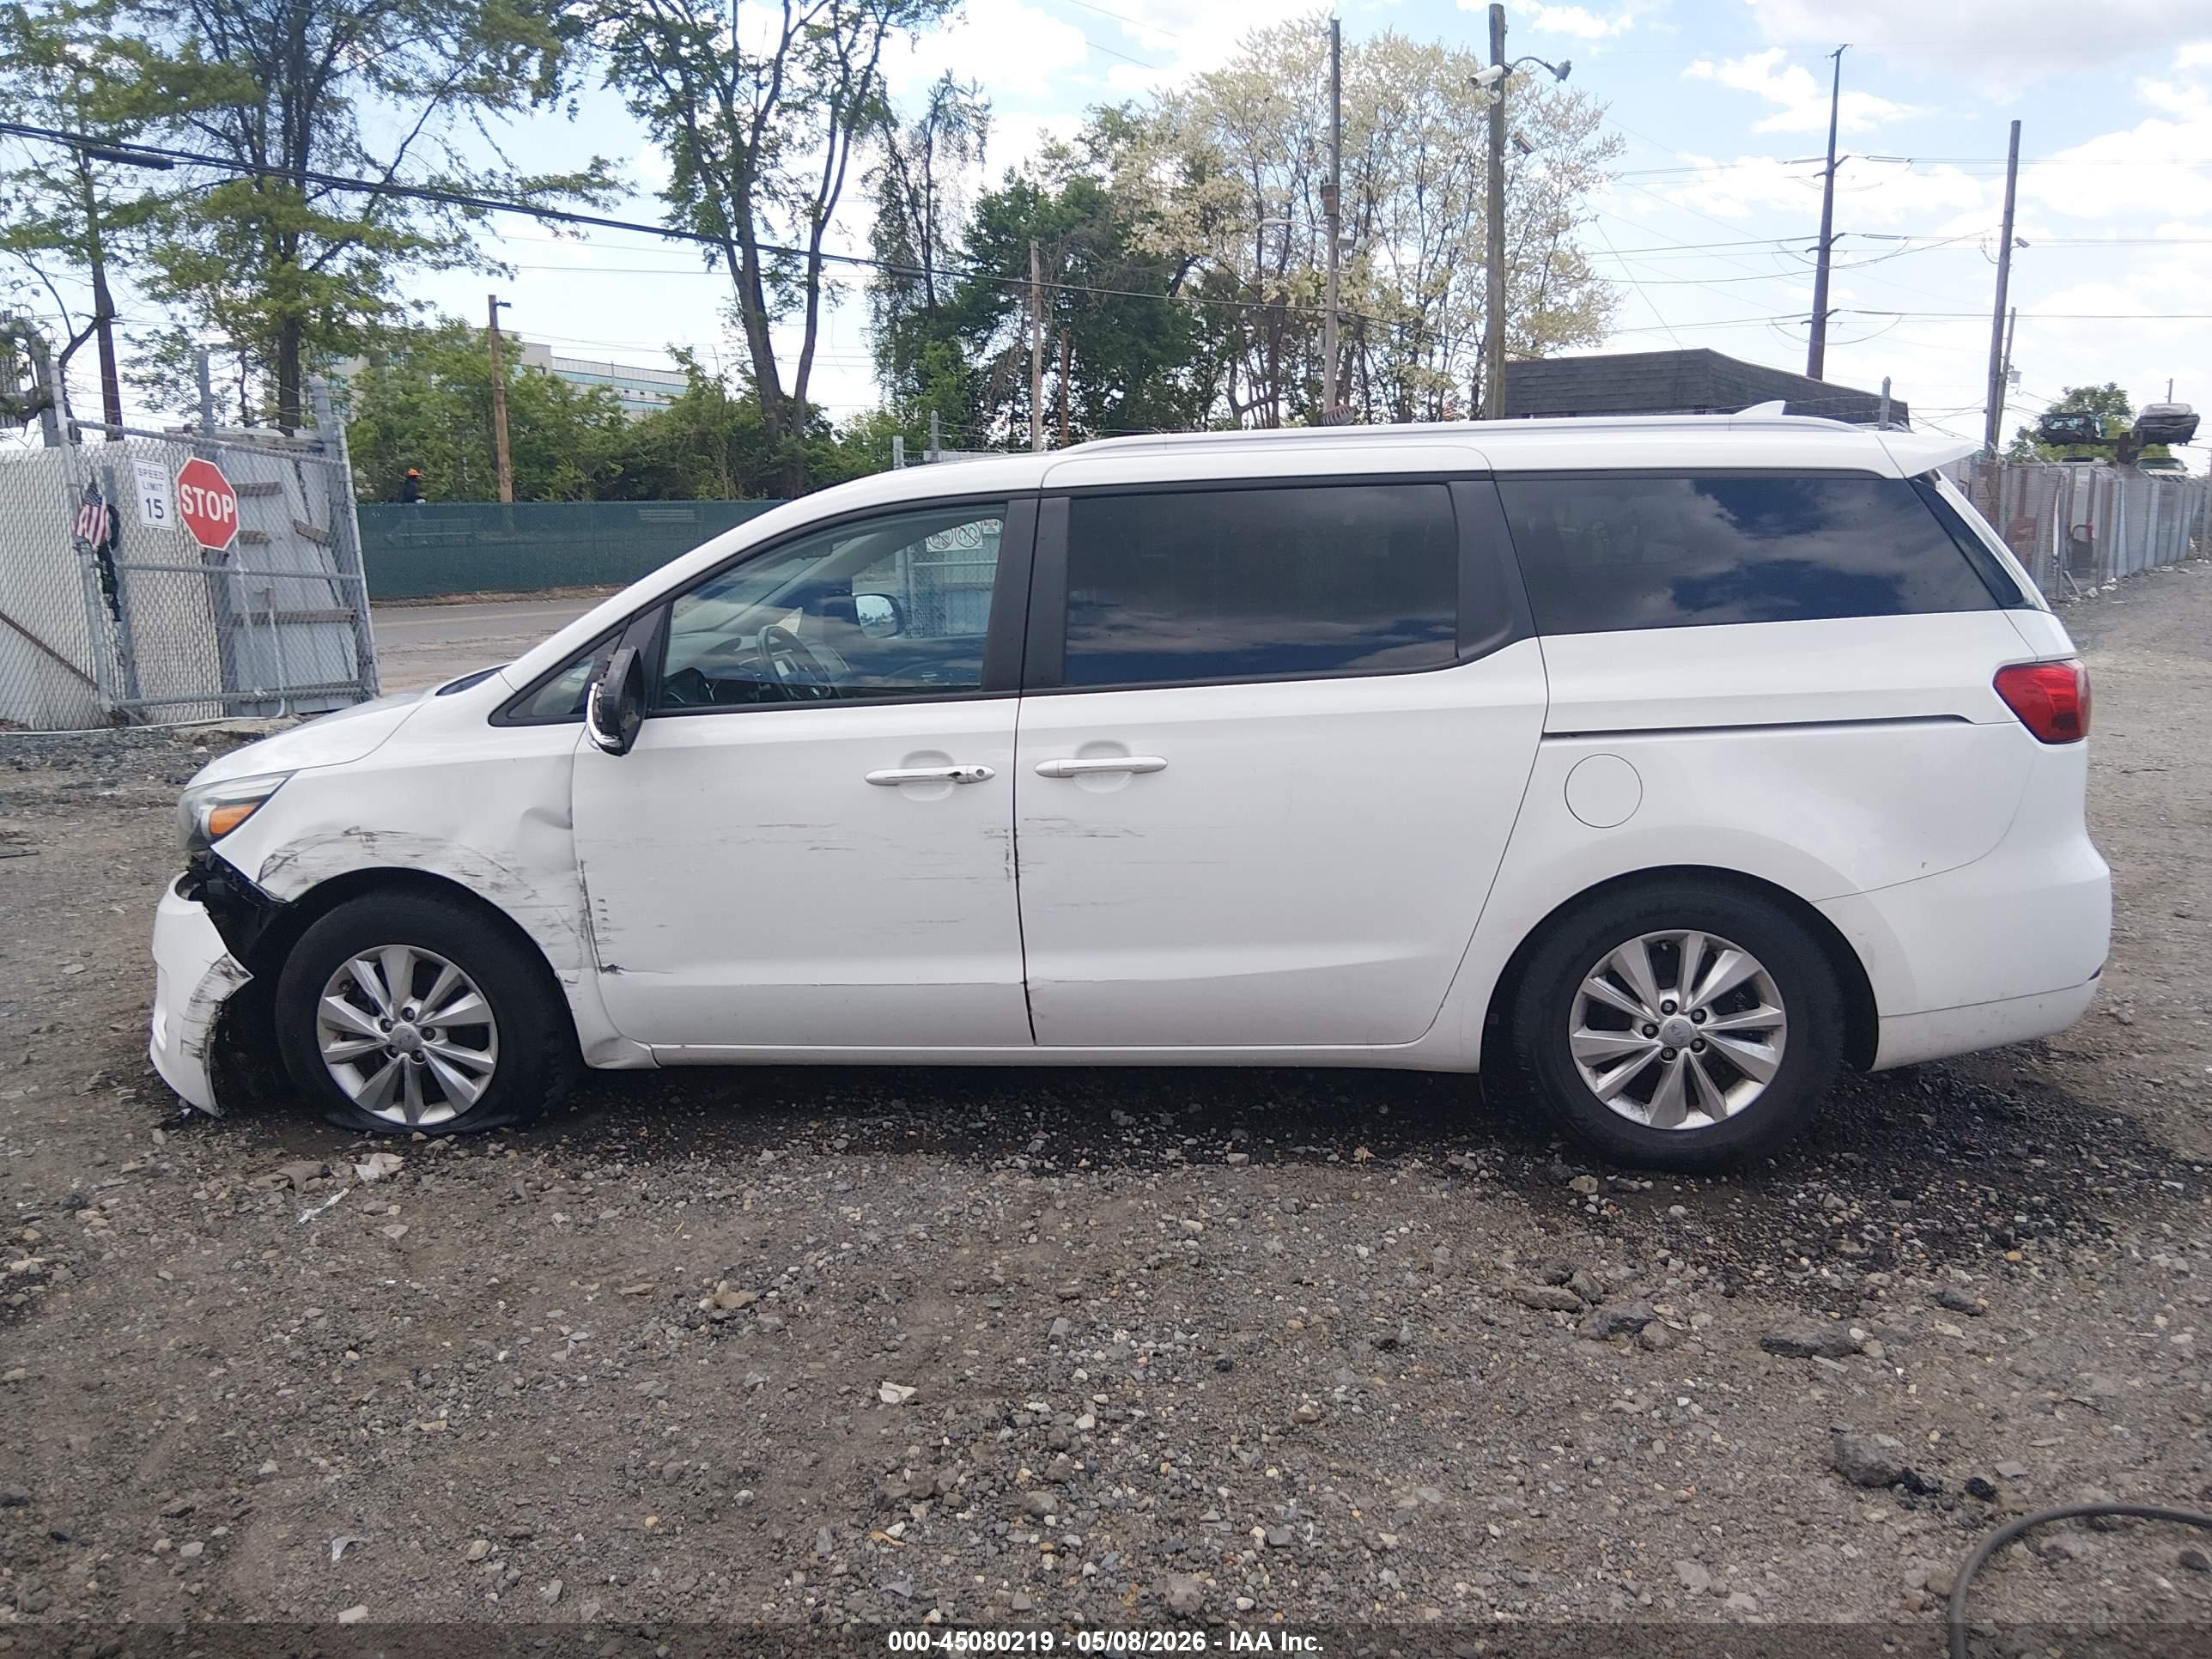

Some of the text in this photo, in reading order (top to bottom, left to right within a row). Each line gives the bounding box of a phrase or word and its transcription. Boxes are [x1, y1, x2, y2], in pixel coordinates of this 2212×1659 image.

[137, 467, 165, 480] SPEED
[142, 481, 164, 492] LIMIT
[144, 497, 165, 520] 15
[180, 483, 234, 523] STOP
